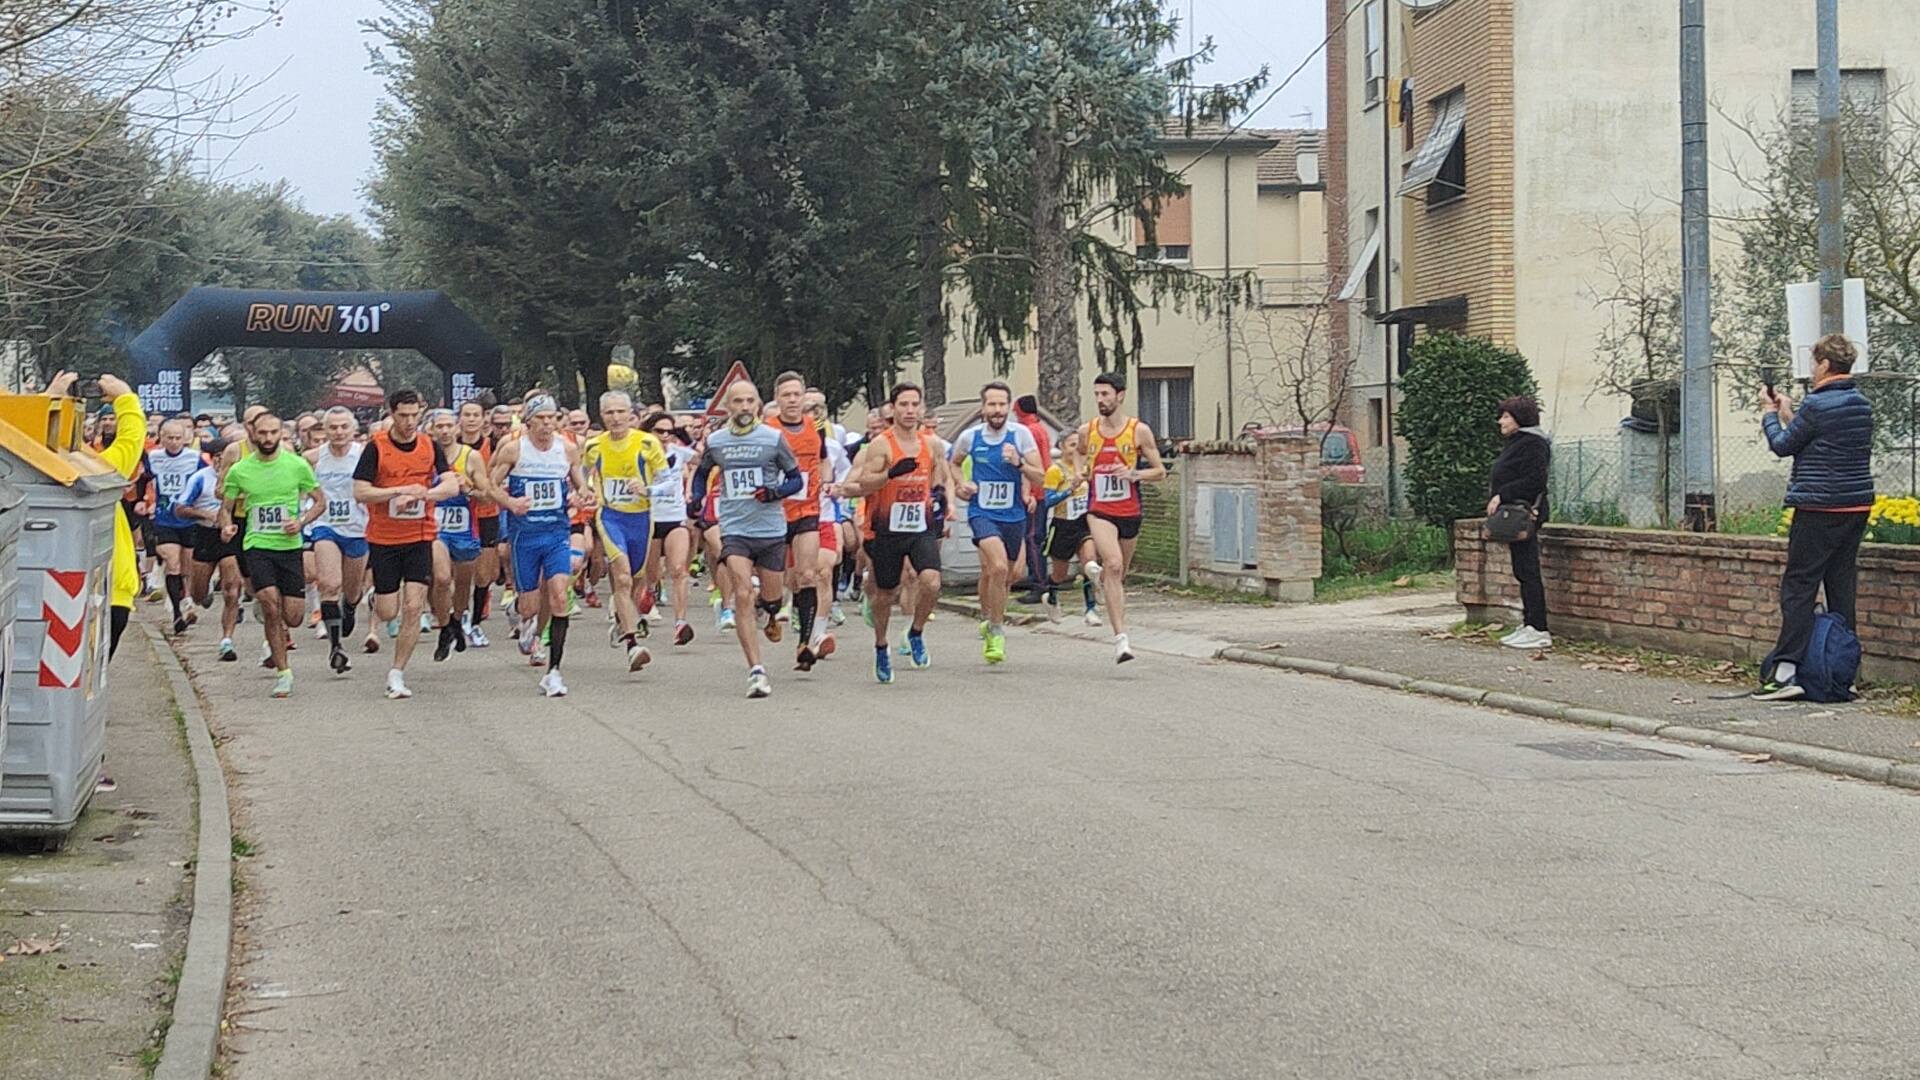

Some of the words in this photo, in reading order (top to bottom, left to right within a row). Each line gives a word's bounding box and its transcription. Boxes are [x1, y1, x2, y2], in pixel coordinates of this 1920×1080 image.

[246, 303, 334, 332] RUN
[337, 302, 391, 333] 361°
[158, 370, 182, 384] ONE
[452, 373, 475, 387] ONE
[138, 384, 182, 398] DEGREE
[163, 474, 181, 487] 542
[731, 470, 755, 489] 649
[1104, 475, 1124, 491] 781
[533, 482, 556, 500] 698
[989, 483, 1008, 499] 713
[258, 506, 282, 523] 658
[329, 500, 350, 516] 633
[441, 507, 463, 524] 726
[899, 504, 921, 522] 765
